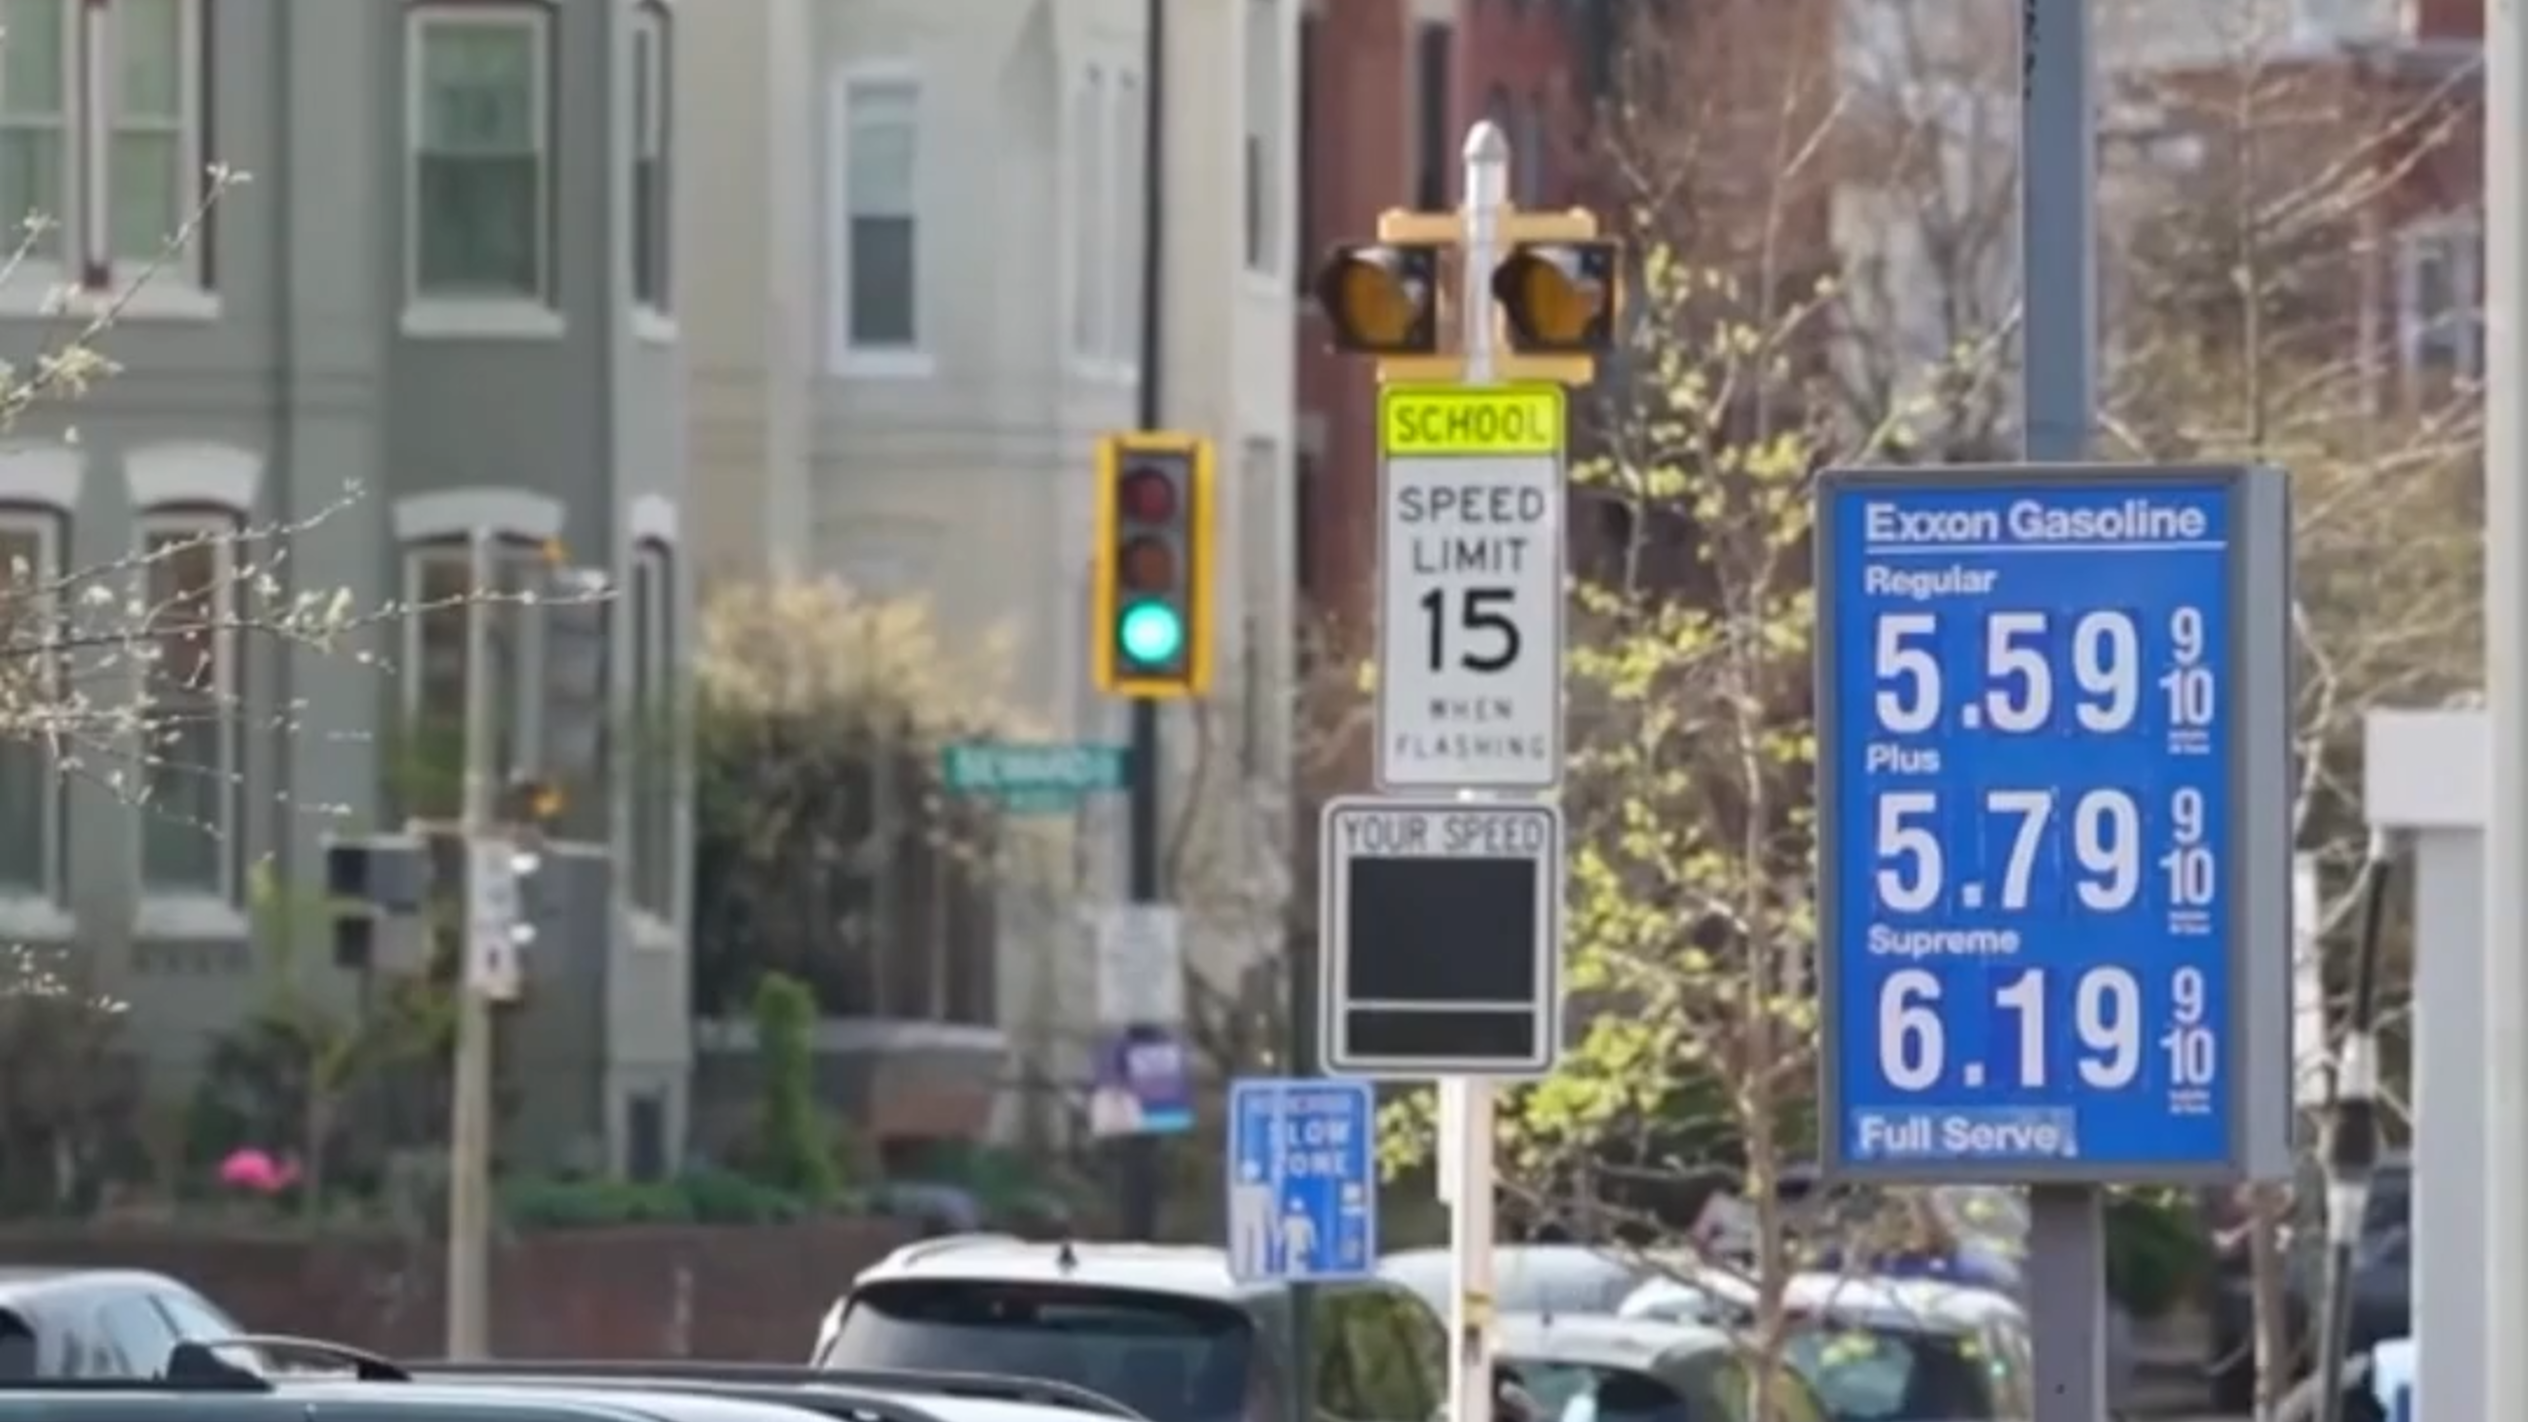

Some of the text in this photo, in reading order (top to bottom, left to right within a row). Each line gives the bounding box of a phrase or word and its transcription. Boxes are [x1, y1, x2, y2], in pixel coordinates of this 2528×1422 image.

[1395, 404, 1549, 444] SCHOOL
[1398, 485, 1546, 523] SPEED
[1865, 499, 2207, 542] Exxon Gasoline
[1413, 536, 1529, 574] LIMIT
[1865, 565, 1998, 601] Regular
[1419, 586, 1522, 674] 15
[2171, 606, 2203, 665] 9
[1875, 611, 2140, 733] 5.59
[1429, 698, 1513, 722] WHEN
[2158, 667, 2215, 727] 10
[1396, 734, 1546, 761] FLASHING
[1866, 744, 1940, 774] Plus
[1344, 815, 1545, 853] YOUR SPEED
[2171, 787, 2203, 845] 9
[1876, 788, 2141, 913] 5.79
[2158, 848, 2215, 906] 10
[1868, 923, 2021, 960] Supreme
[2172, 965, 2204, 1024] 9
[1878, 964, 2141, 1092] 6.19
[2159, 1028, 2216, 1086] 10
[1859, 1115, 2060, 1153] Full Serve
